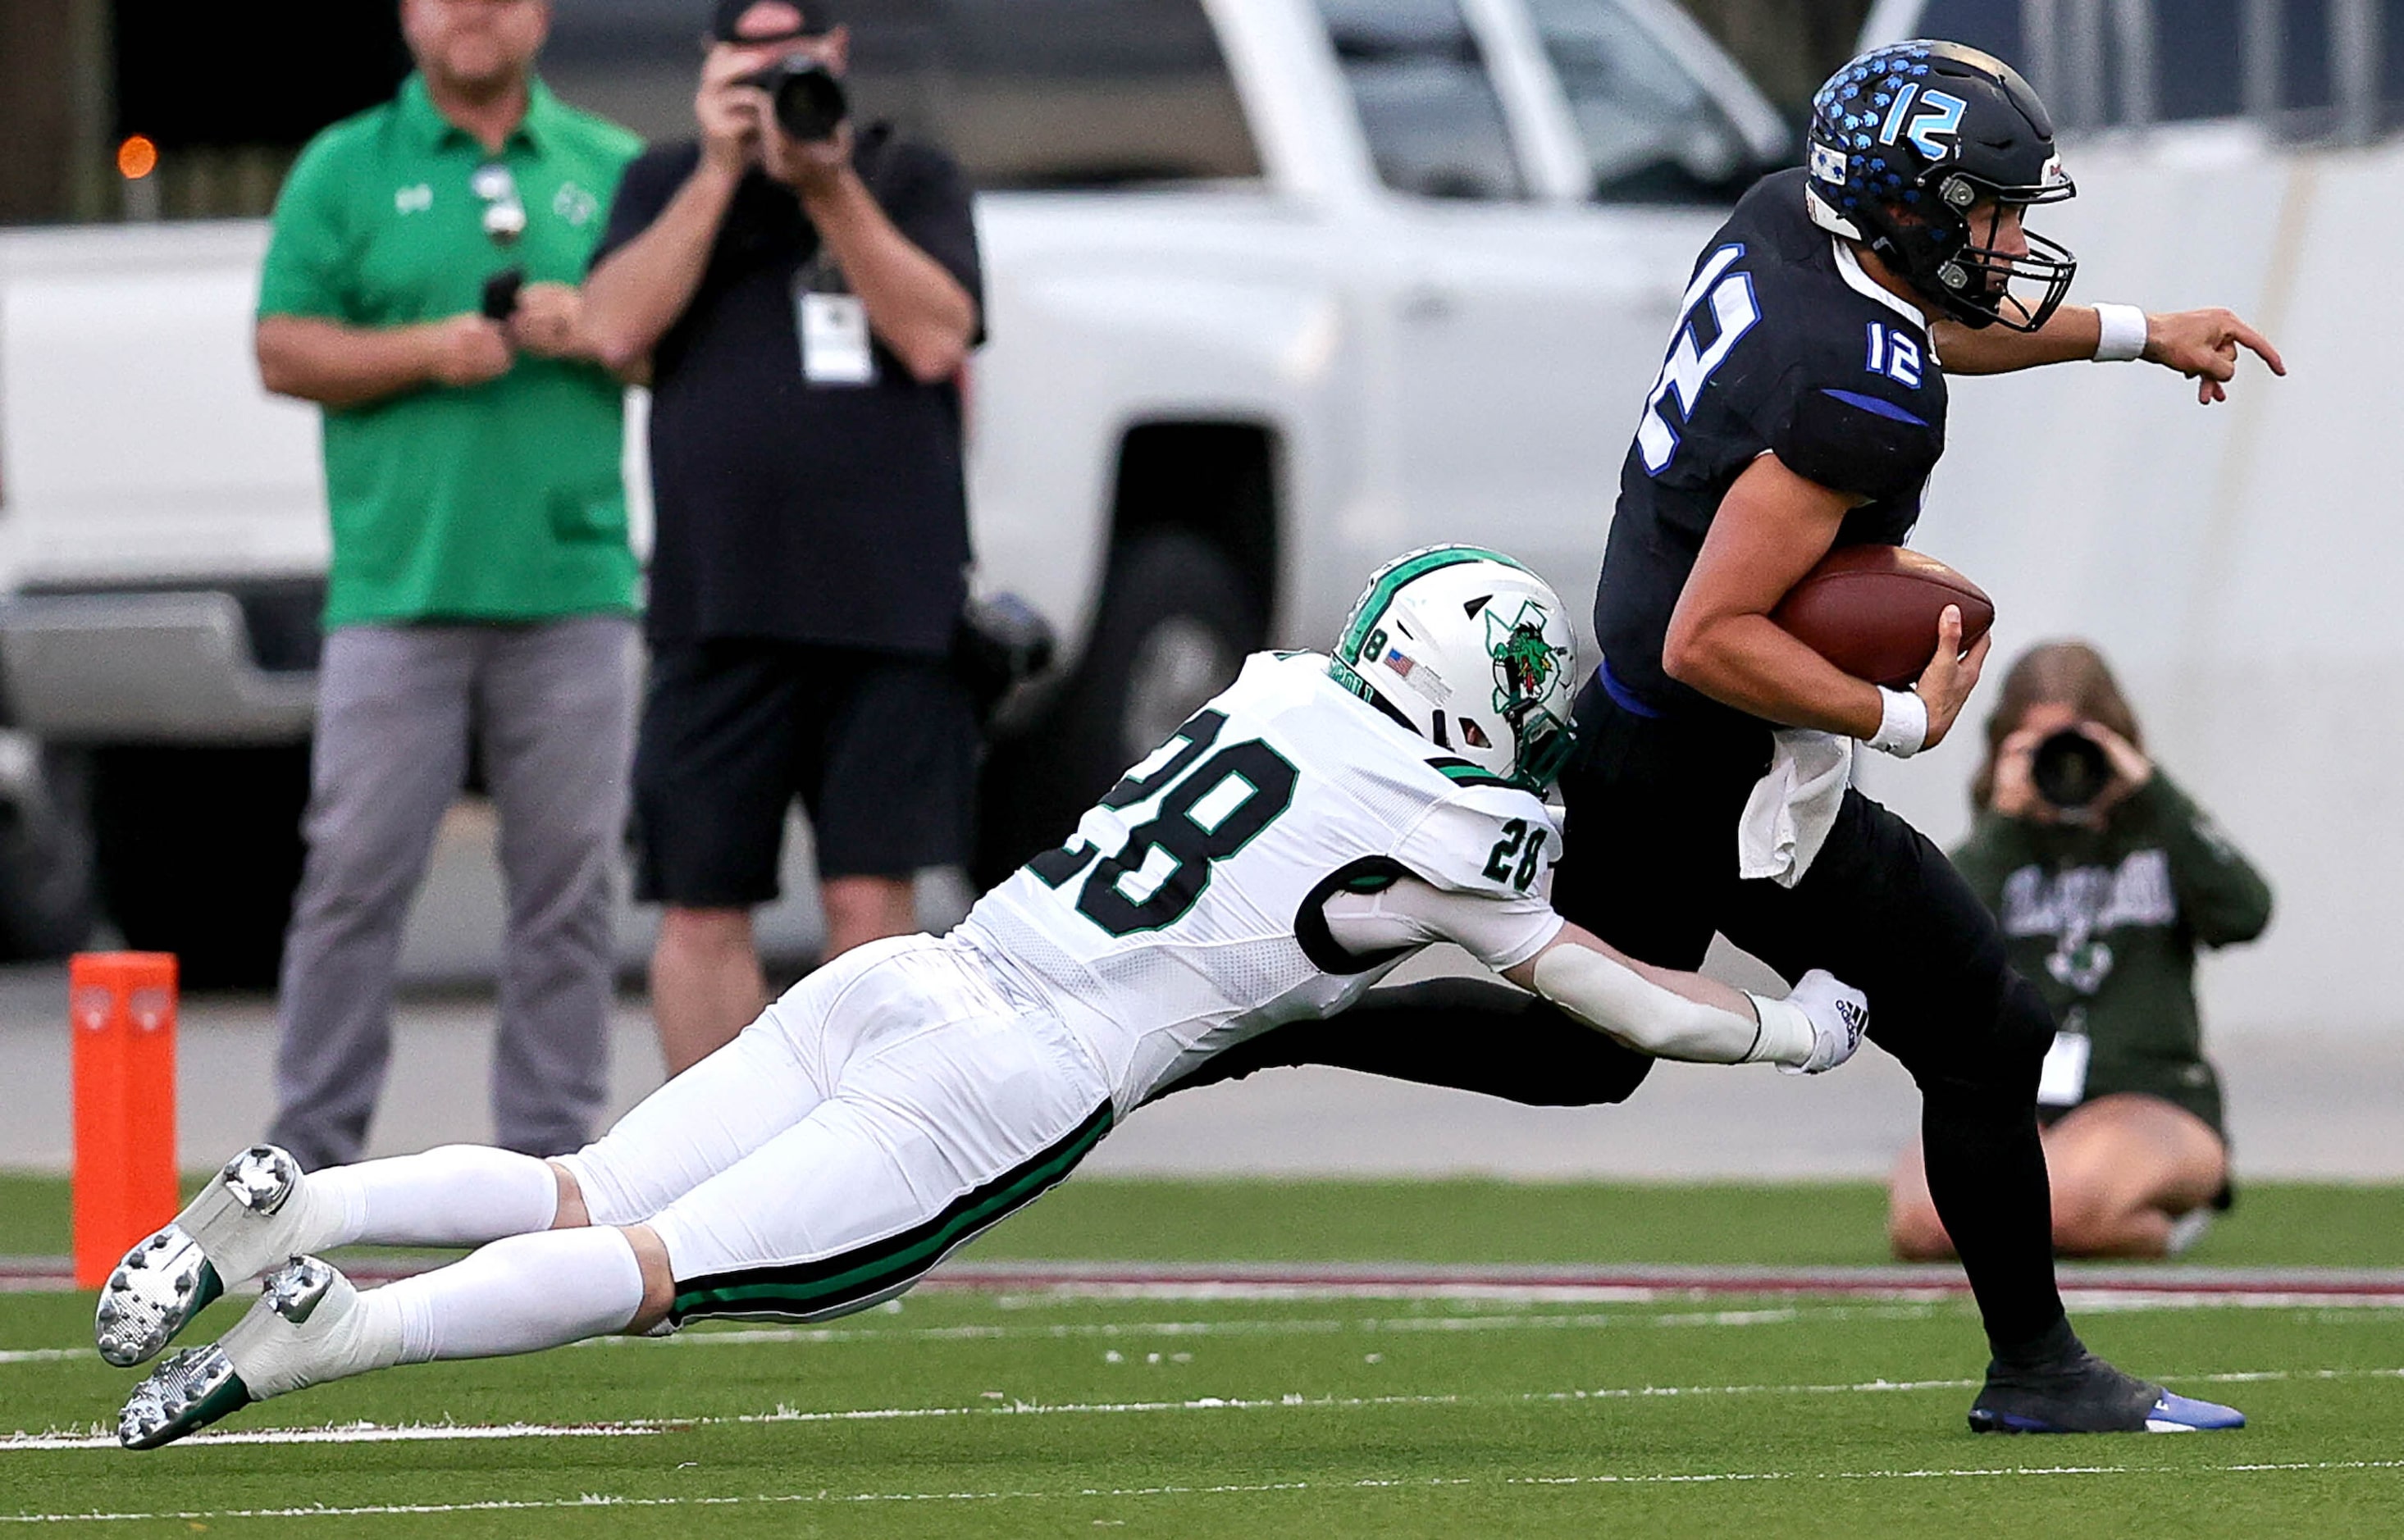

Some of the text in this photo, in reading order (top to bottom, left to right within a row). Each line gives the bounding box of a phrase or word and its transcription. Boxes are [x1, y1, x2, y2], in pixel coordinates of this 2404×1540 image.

[1879, 82, 1968, 162] 12
[1637, 243, 1763, 477] 12
[1865, 320, 1923, 390] 12
[1024, 707, 1300, 938] 28
[1481, 817, 1548, 892] 28
[1836, 999, 1857, 1050] adidas
